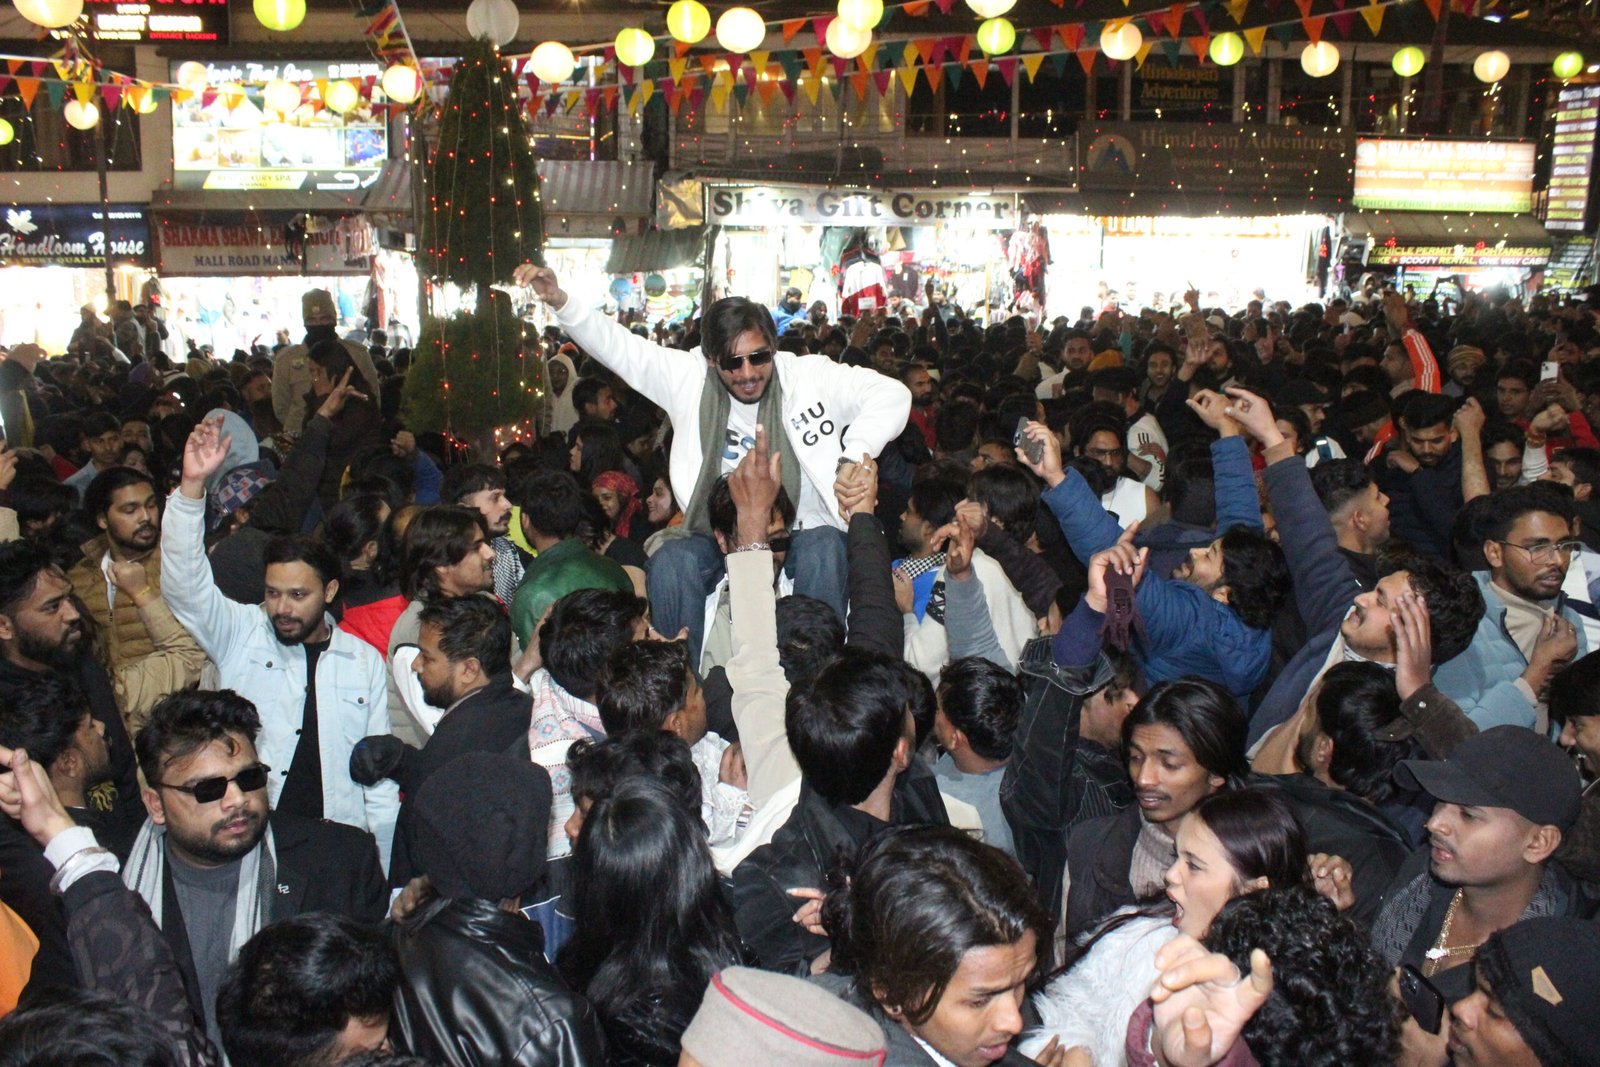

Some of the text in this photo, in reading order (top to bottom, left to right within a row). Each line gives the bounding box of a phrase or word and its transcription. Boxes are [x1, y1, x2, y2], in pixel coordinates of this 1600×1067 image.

[1140, 83, 1218, 99] Adventures
[1141, 128, 1347, 151] Himalayan Adventures
[816, 191, 883, 217] Gift
[892, 193, 1010, 219] Corner
[0, 231, 145, 255] Handloom Huse
[1371, 246, 1414, 255] VEHICLE
[1415, 246, 1453, 255] PERMIT
[1523, 248, 1552, 256] PASS
[194, 255, 226, 266] MALL
[228, 256, 260, 266] ROAD
[1369, 256, 1391, 264] BIKE
[1399, 256, 1439, 264] SCOOTY
[1478, 256, 1500, 265] ONE
[1501, 257, 1521, 265] WAY
[1521, 257, 1549, 265] CABS
[791, 401, 825, 431] HU
[802, 419, 835, 446] GO
